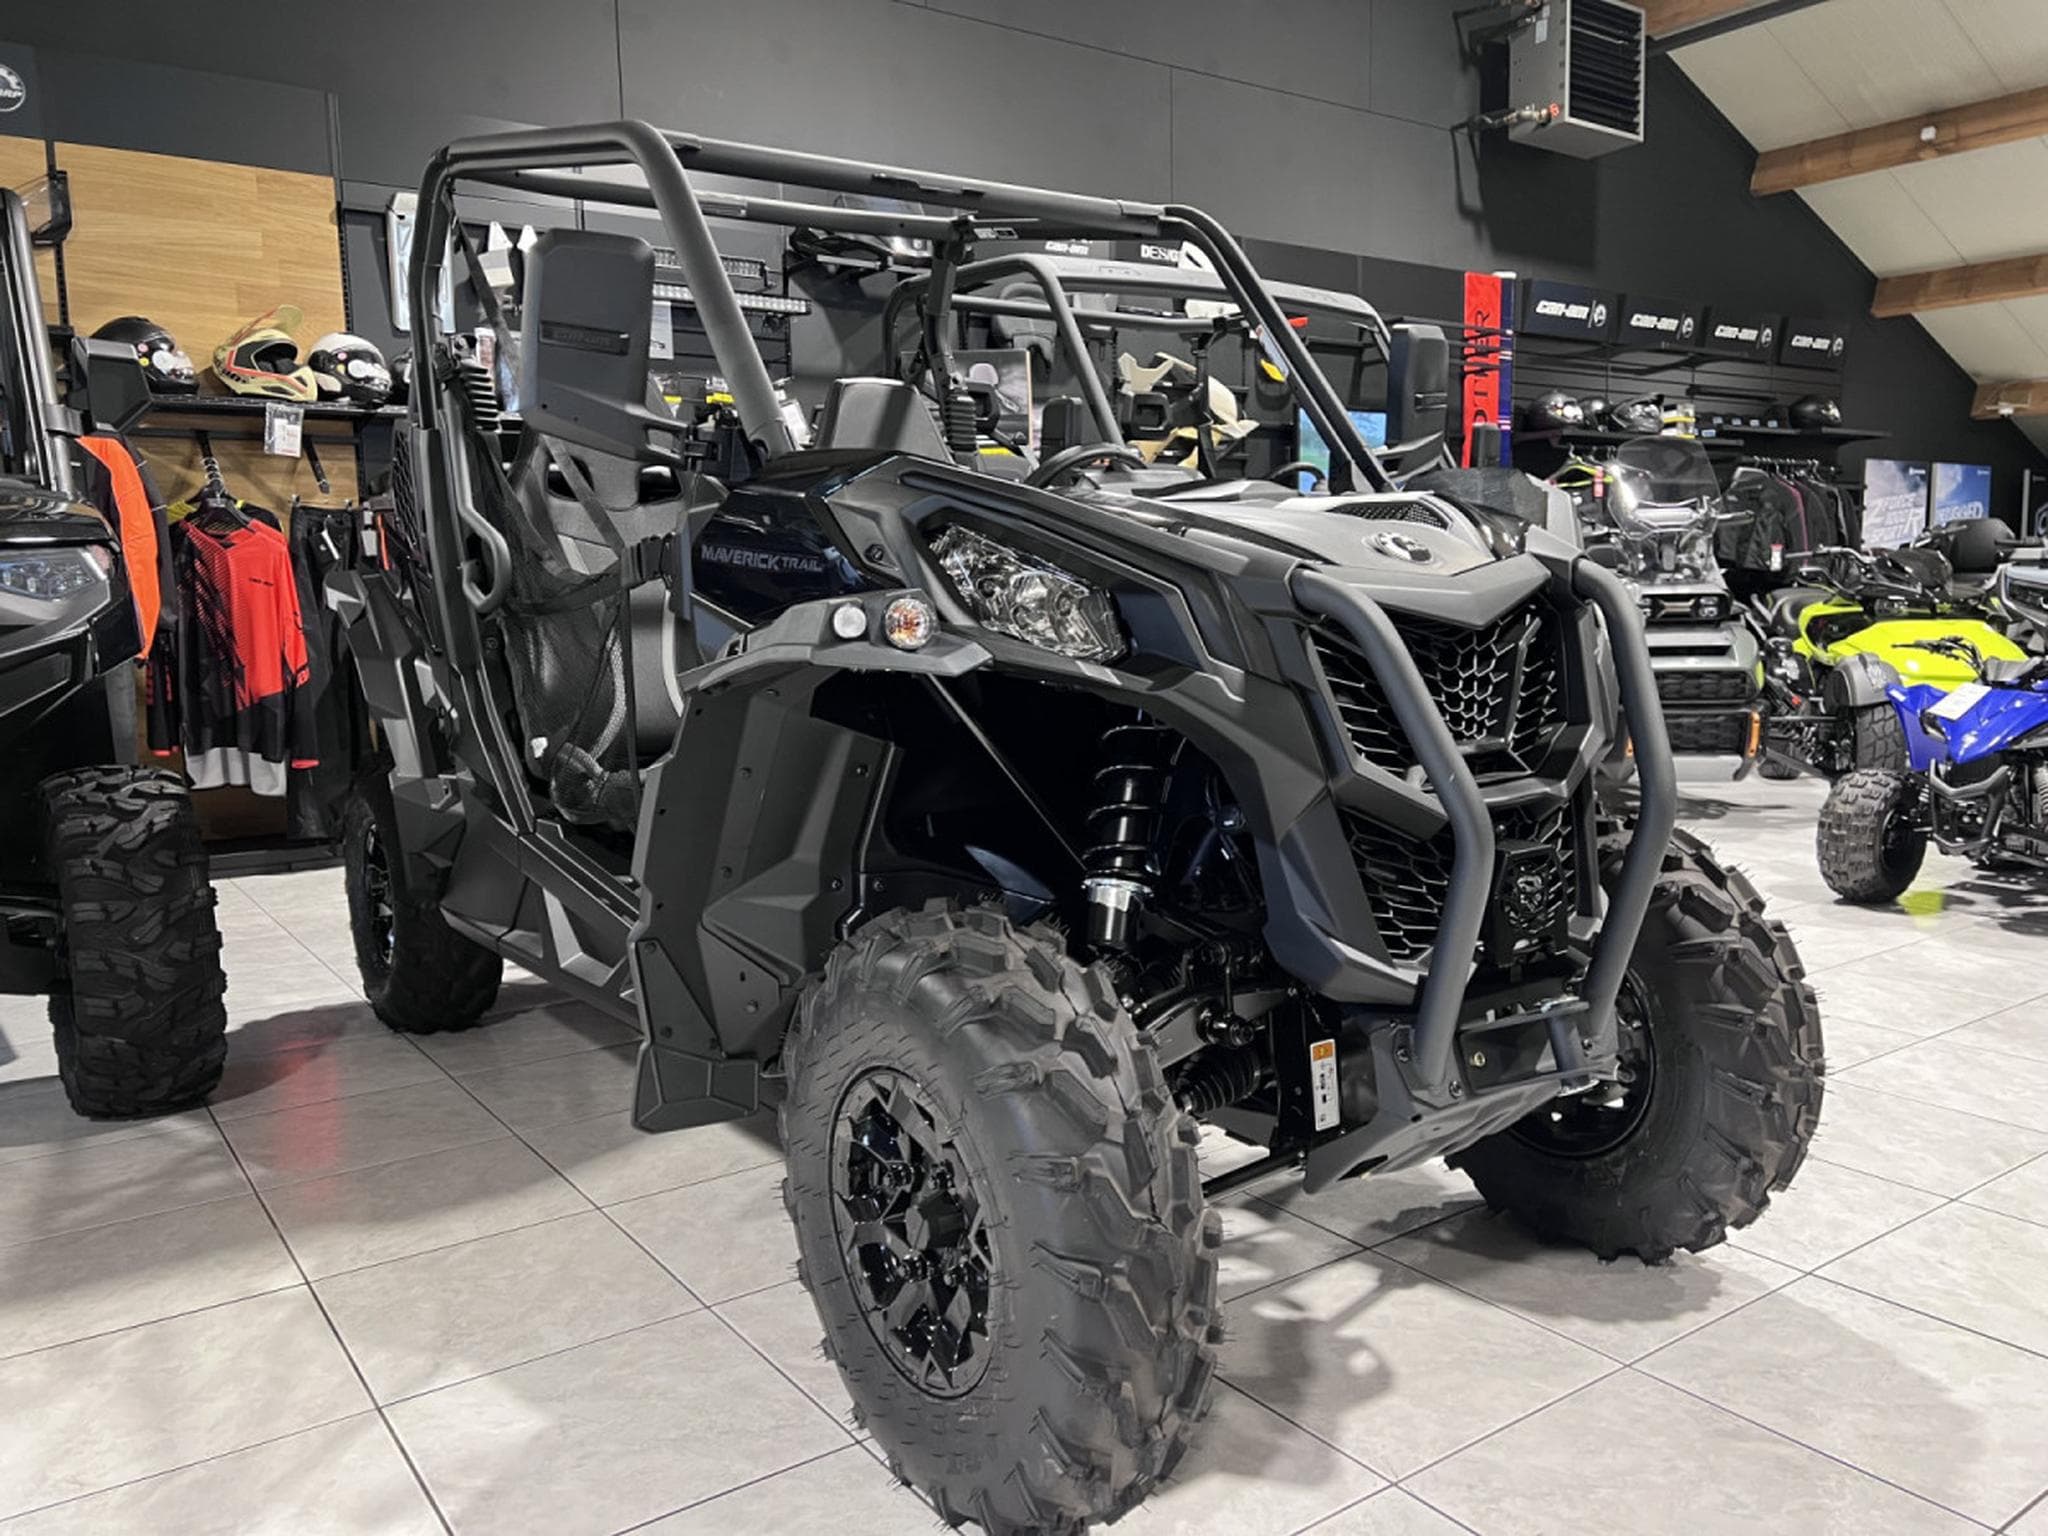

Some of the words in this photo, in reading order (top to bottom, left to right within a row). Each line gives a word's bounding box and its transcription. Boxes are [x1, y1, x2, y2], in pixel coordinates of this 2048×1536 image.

[1140, 244, 1179, 262] DESIG
[701, 544, 779, 571] MAVERICK
[781, 556, 823, 572] TRAIL
